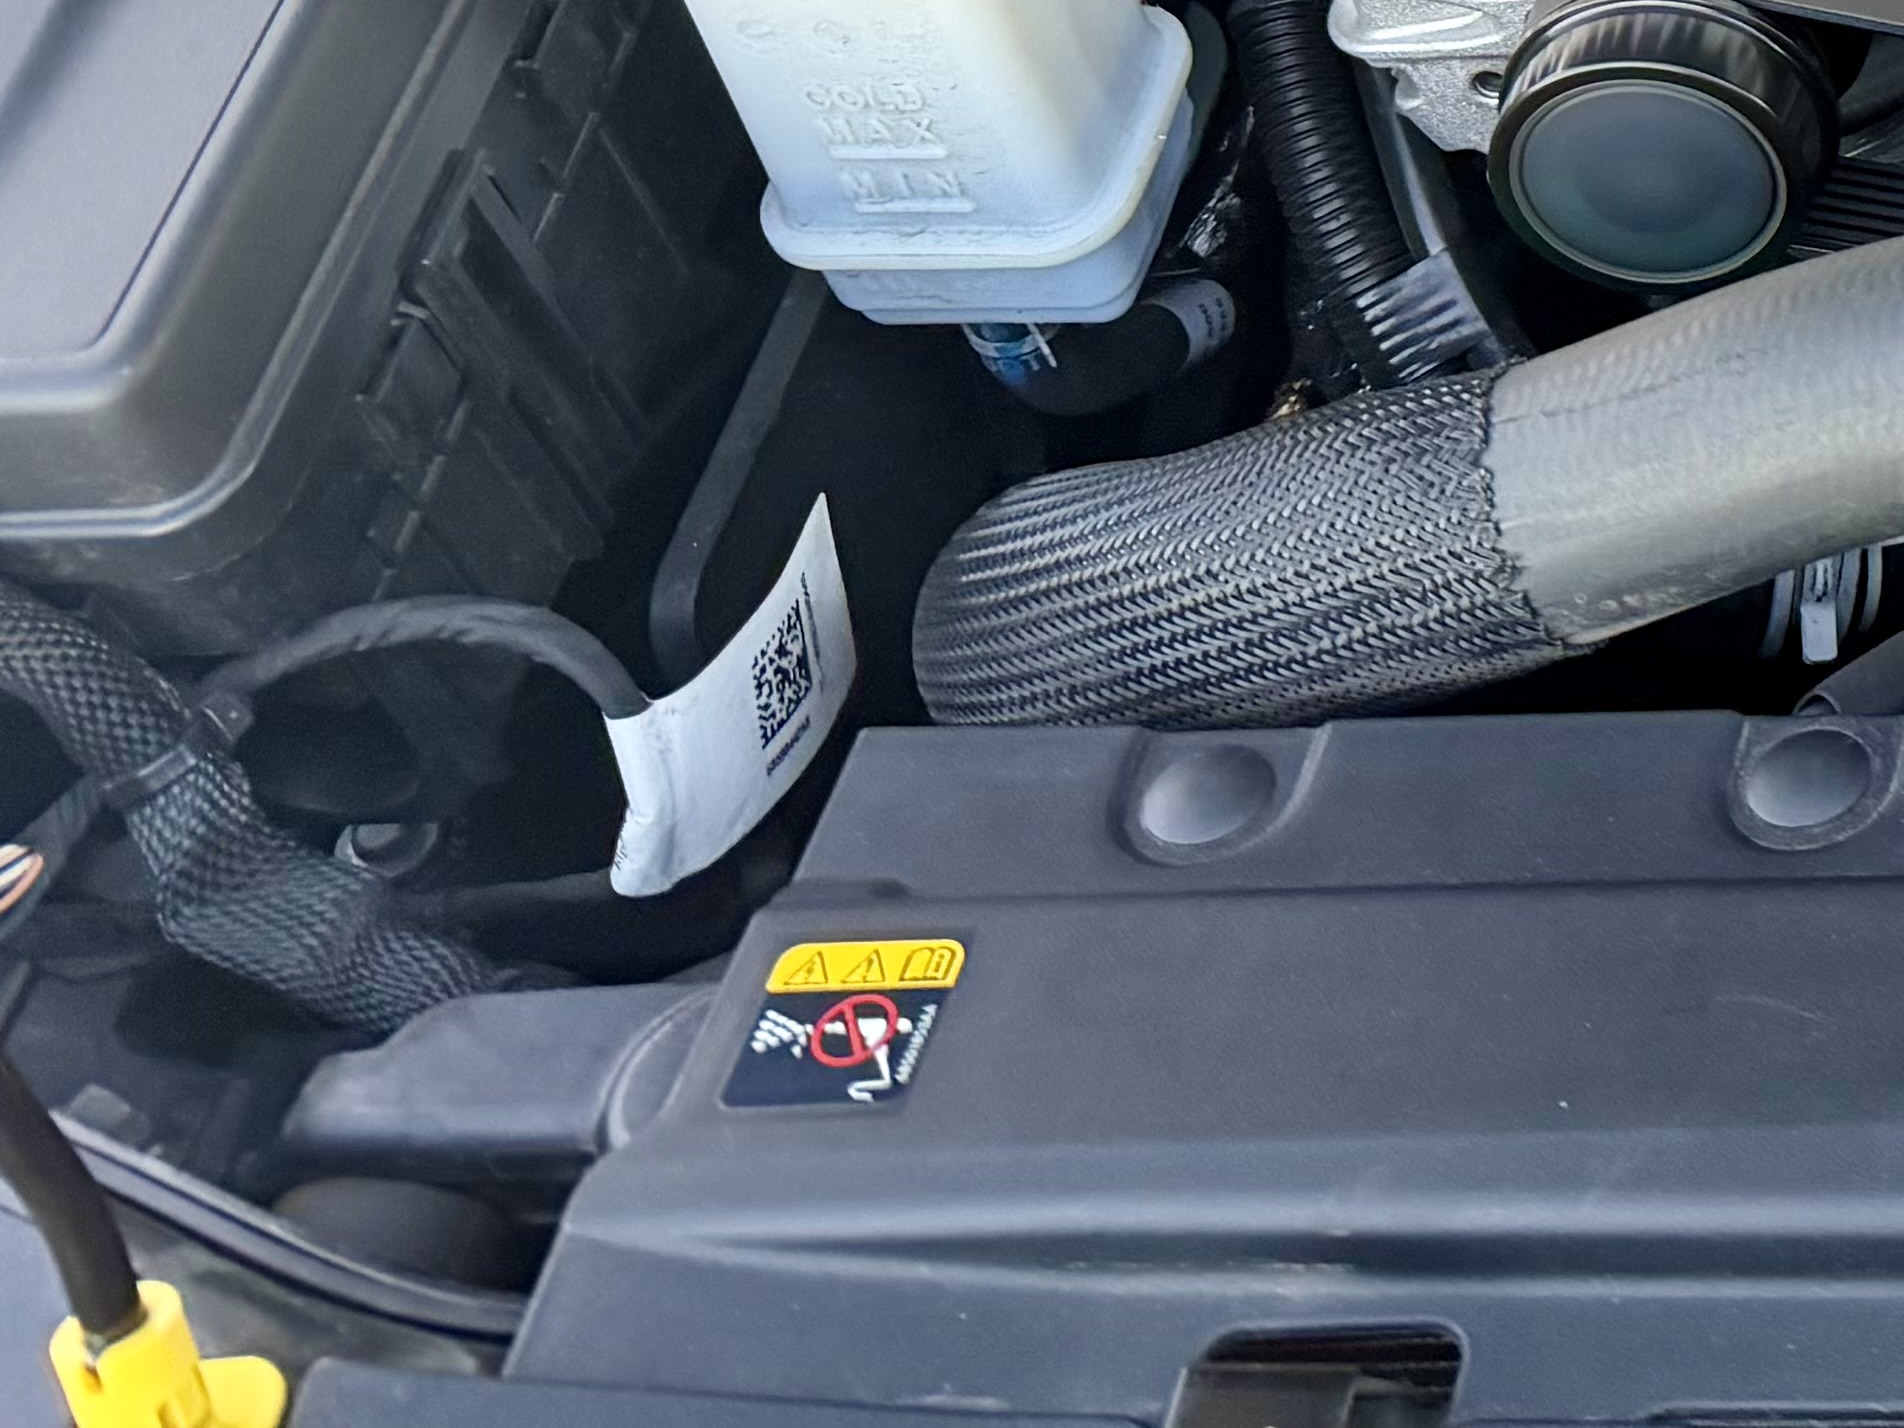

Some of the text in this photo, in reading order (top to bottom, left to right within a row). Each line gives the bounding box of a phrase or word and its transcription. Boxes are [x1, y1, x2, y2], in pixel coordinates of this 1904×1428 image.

[803, 83, 925, 112] COLD
[815, 118, 941, 145] MAX
[841, 170, 967, 198] MIN
